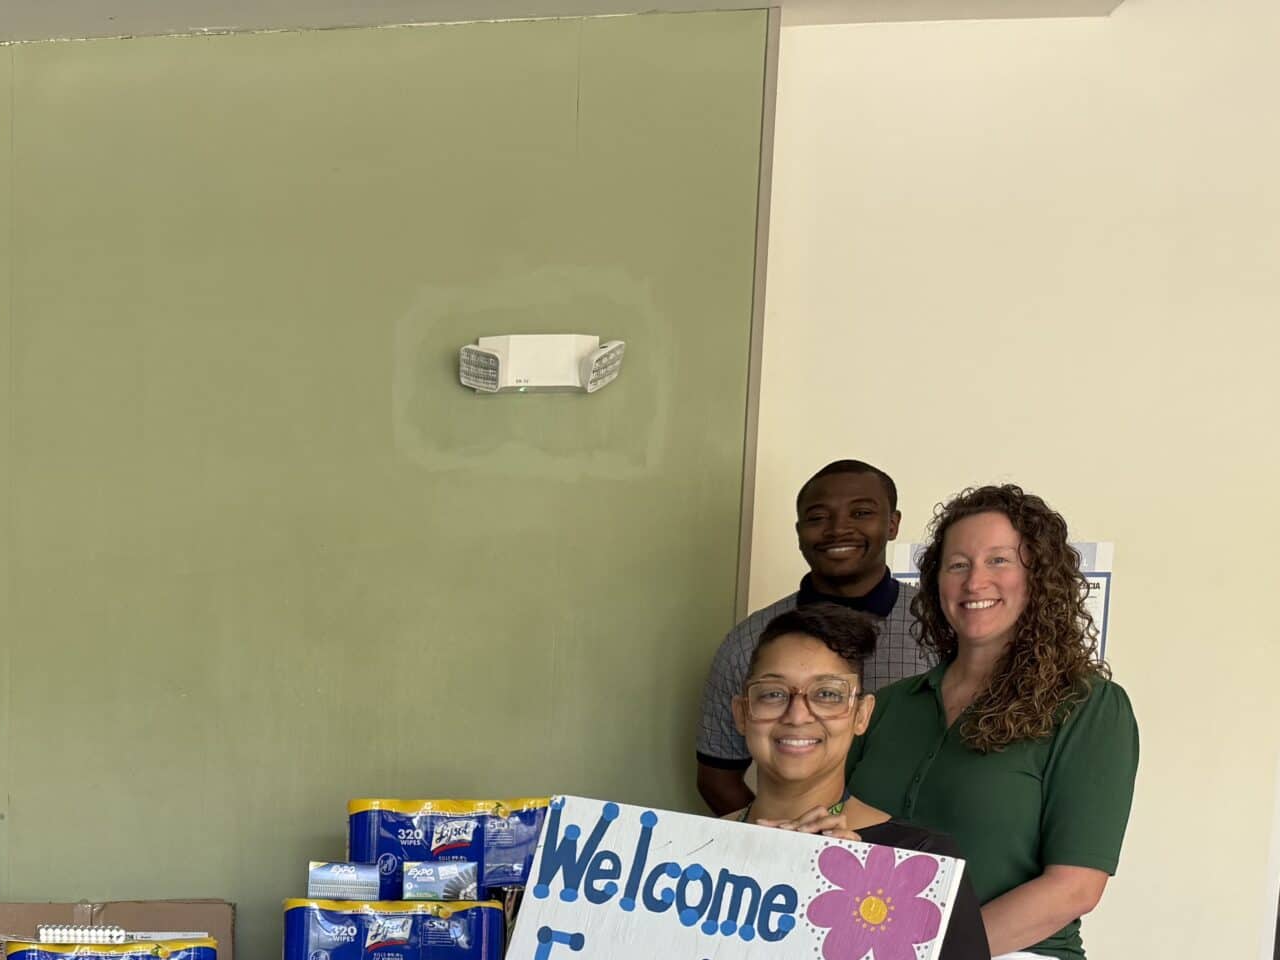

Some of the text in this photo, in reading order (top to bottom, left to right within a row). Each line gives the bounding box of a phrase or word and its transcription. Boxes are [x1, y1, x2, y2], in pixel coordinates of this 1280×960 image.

[397, 829, 422, 839] 320
[435, 821, 470, 844] Lysol
[533, 794, 798, 942] Welcome
[330, 926, 357, 936] 320
[370, 918, 409, 941] Lysol
